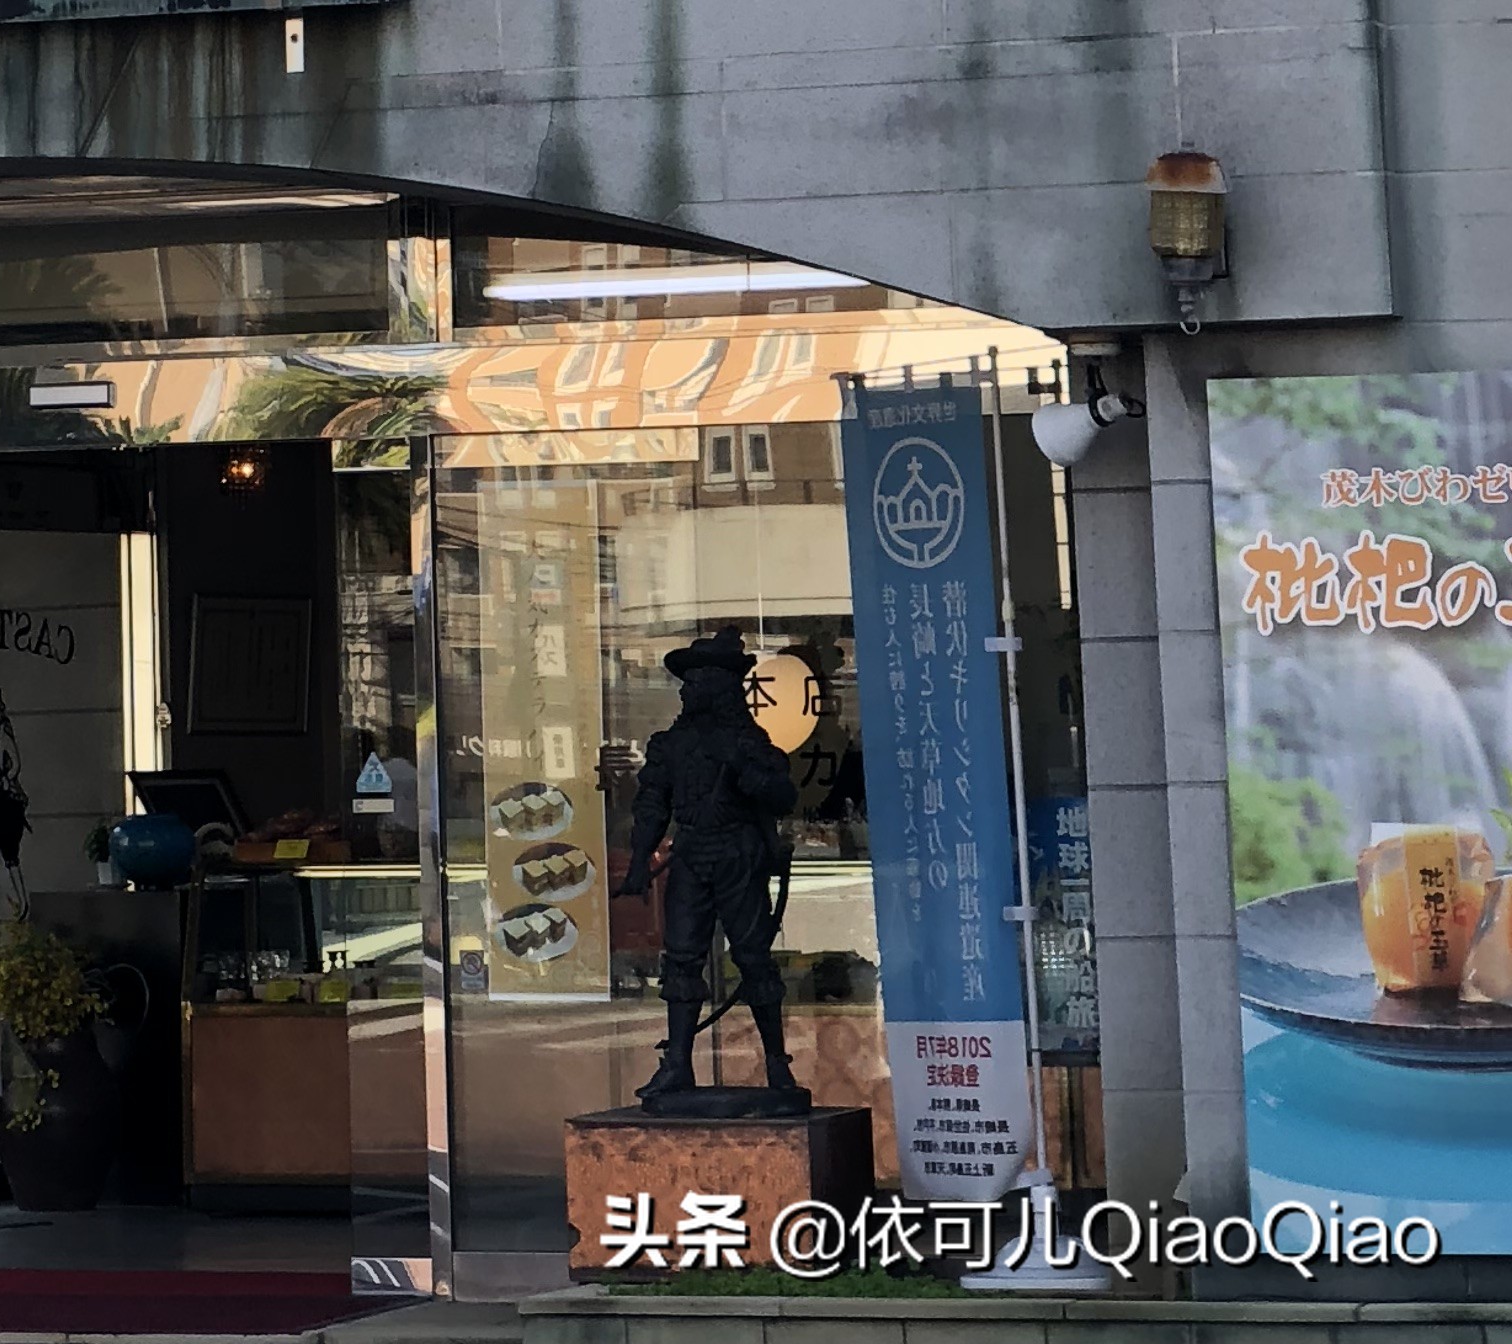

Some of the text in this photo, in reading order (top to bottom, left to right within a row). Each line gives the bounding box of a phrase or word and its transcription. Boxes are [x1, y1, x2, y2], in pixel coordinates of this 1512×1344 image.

[1320, 463, 1512, 508] 茂木びわゼ
[1239, 529, 1512, 636] 枇杷の
